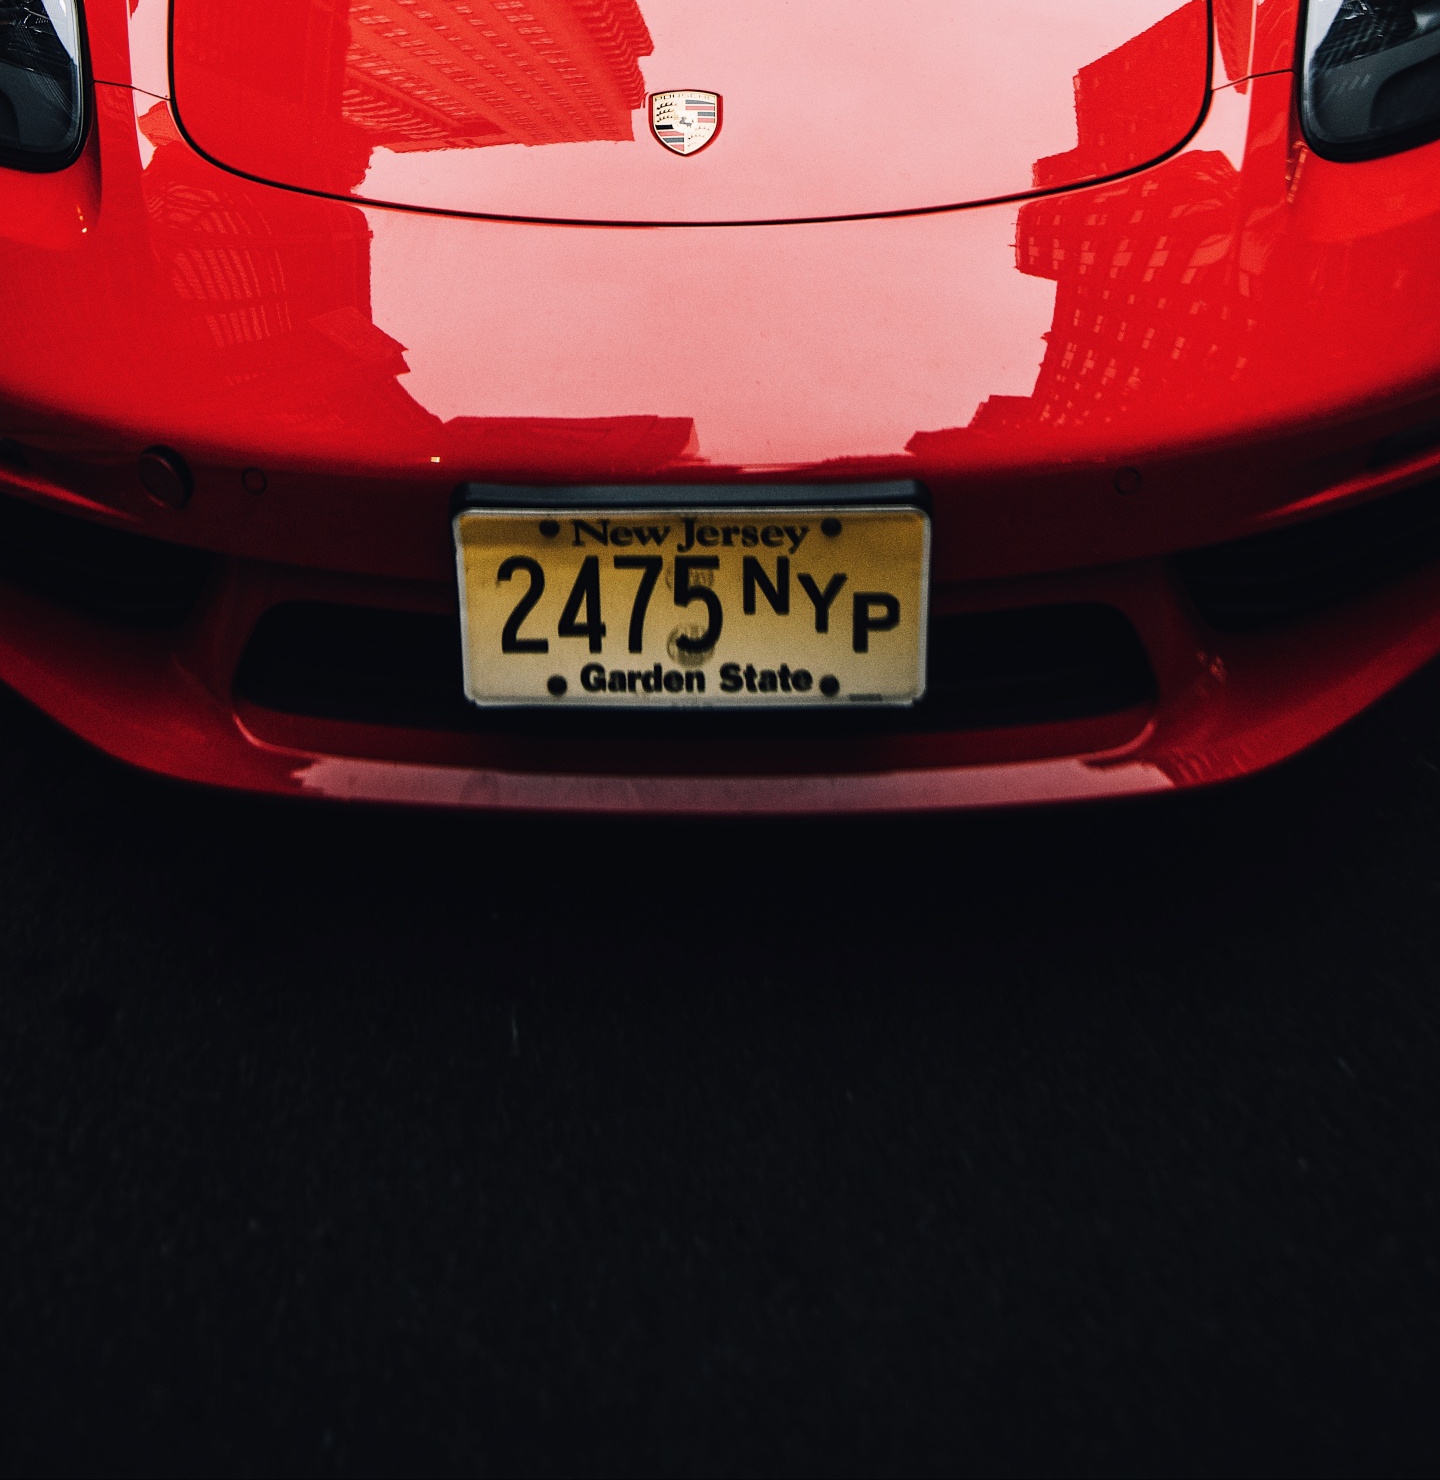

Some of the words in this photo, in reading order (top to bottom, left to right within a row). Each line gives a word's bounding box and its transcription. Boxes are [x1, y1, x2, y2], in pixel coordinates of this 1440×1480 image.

[571, 519, 671, 547] New
[677, 518, 810, 554] Jersey
[580, 662, 705, 694] Garden
[719, 663, 814, 694] State
